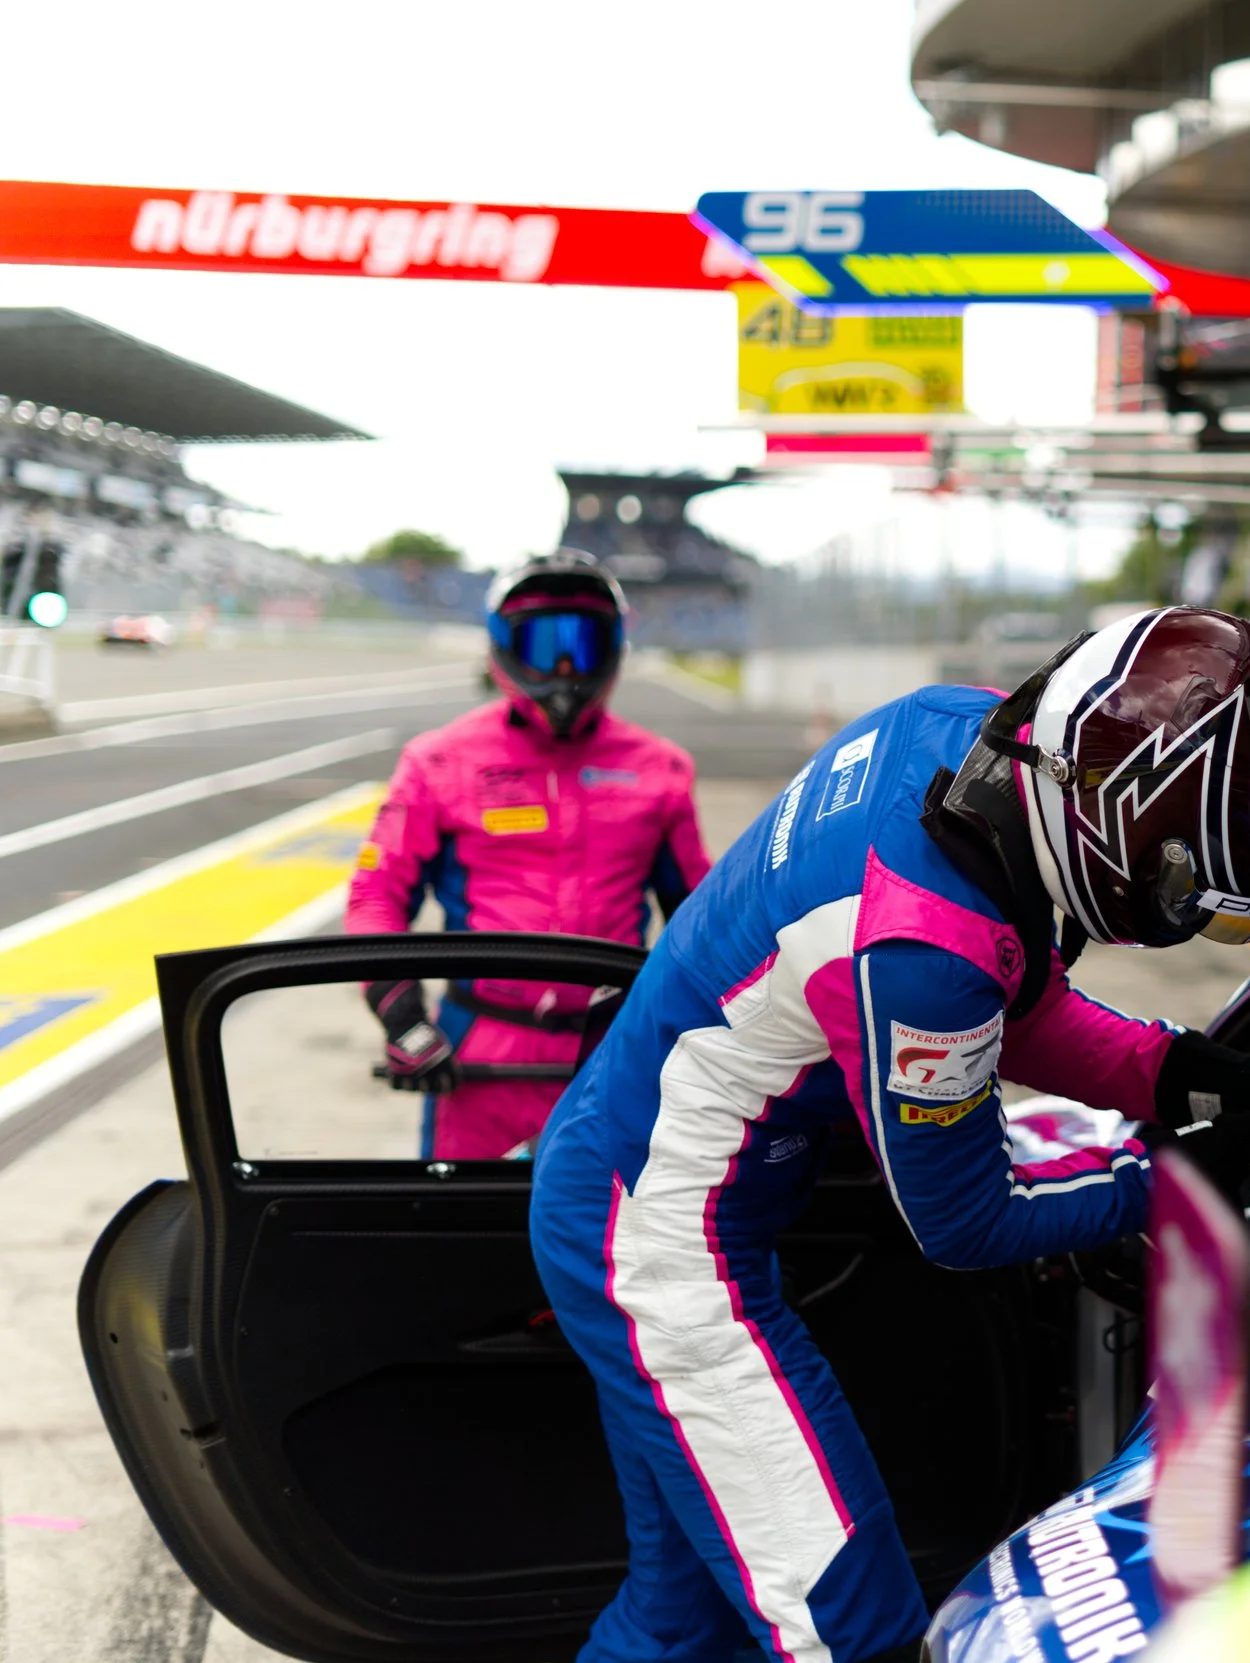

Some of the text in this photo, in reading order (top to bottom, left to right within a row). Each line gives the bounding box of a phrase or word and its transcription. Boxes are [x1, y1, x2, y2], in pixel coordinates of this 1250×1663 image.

[131, 190, 559, 283] nürburgring
[742, 191, 865, 253] 96
[896, 1016, 1001, 1045] INTERCONTINENTA
